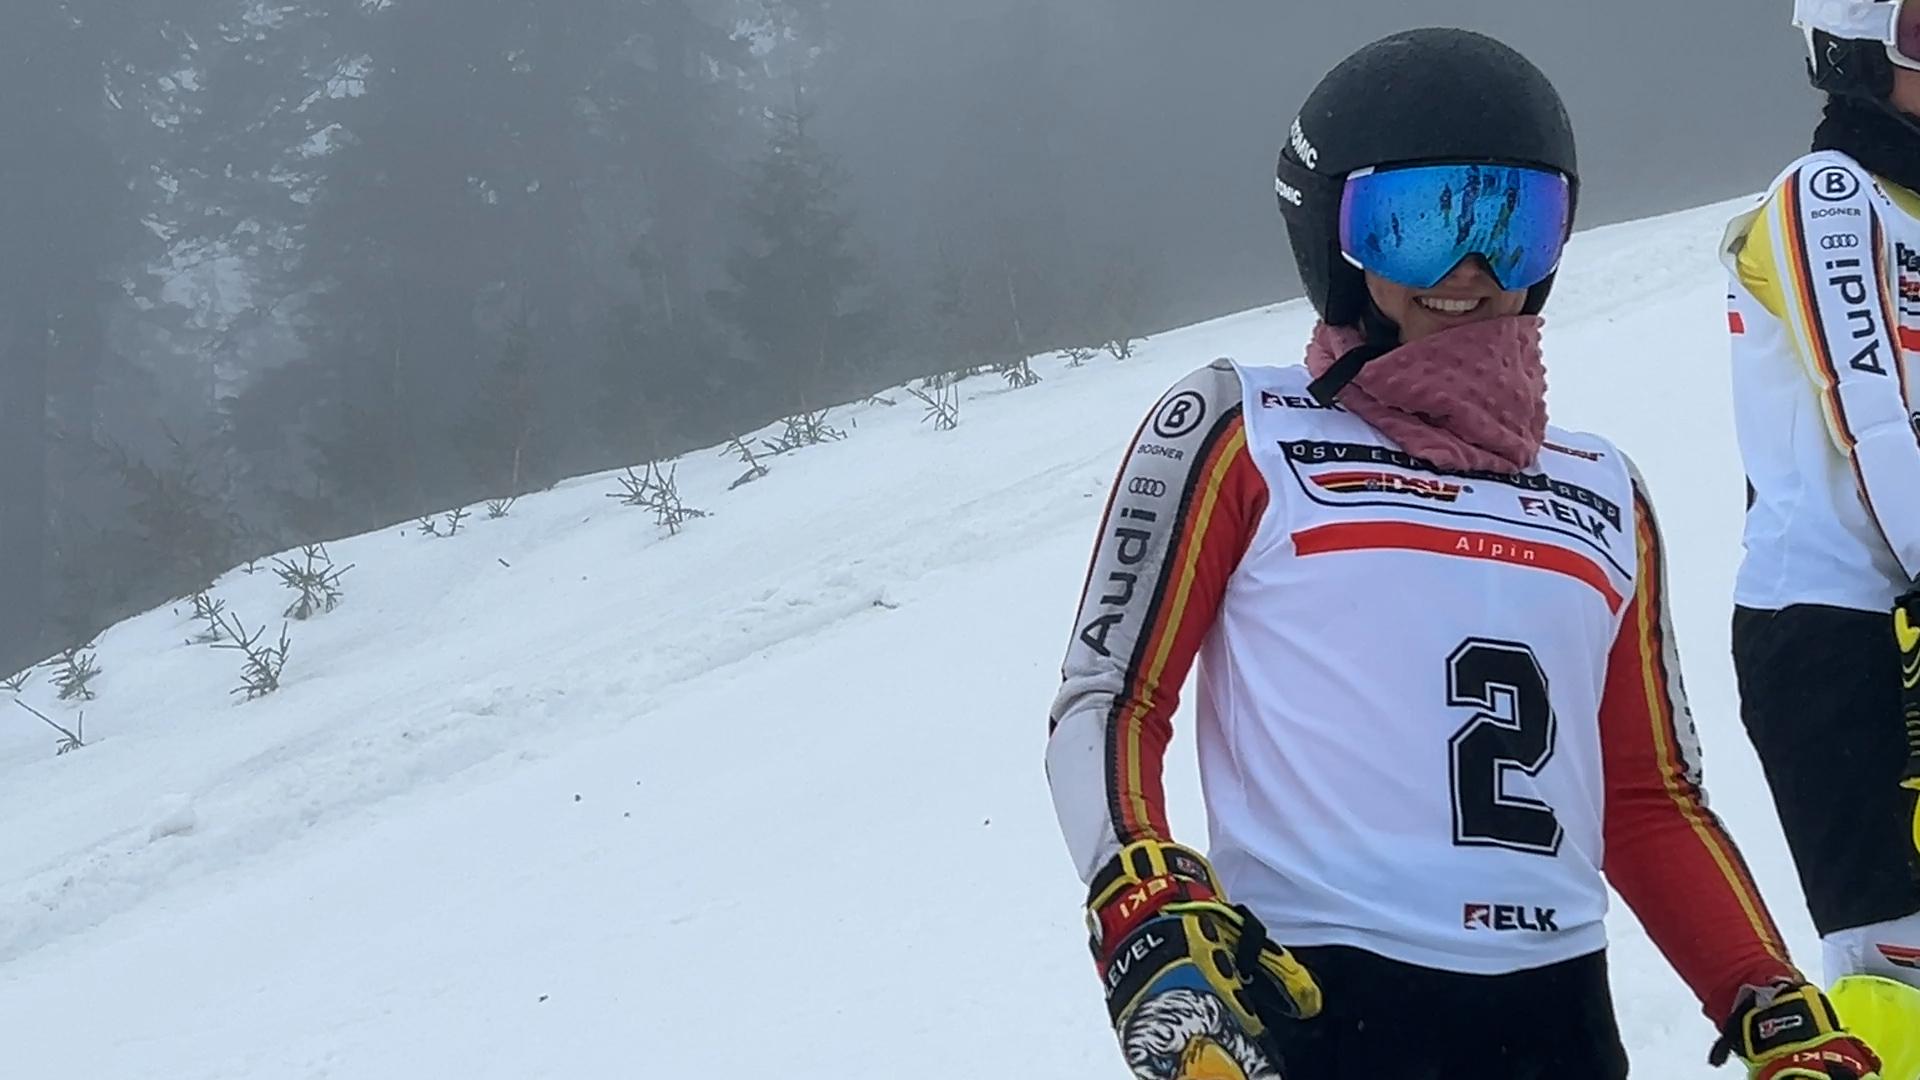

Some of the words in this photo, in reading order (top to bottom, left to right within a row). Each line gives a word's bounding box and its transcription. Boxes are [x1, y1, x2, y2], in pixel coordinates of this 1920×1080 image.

[1811, 207, 1861, 219] BOGNER
[1825, 258, 1887, 377] Audi
[1137, 444, 1184, 461] BOGNER
[1456, 536, 1536, 560] Alpin
[1548, 499, 1611, 549] ELK
[1080, 507, 1157, 657] Audi
[1446, 637, 1564, 857] 2
[1494, 904, 1560, 931] ELK
[1105, 932, 1164, 999] LEVEL
